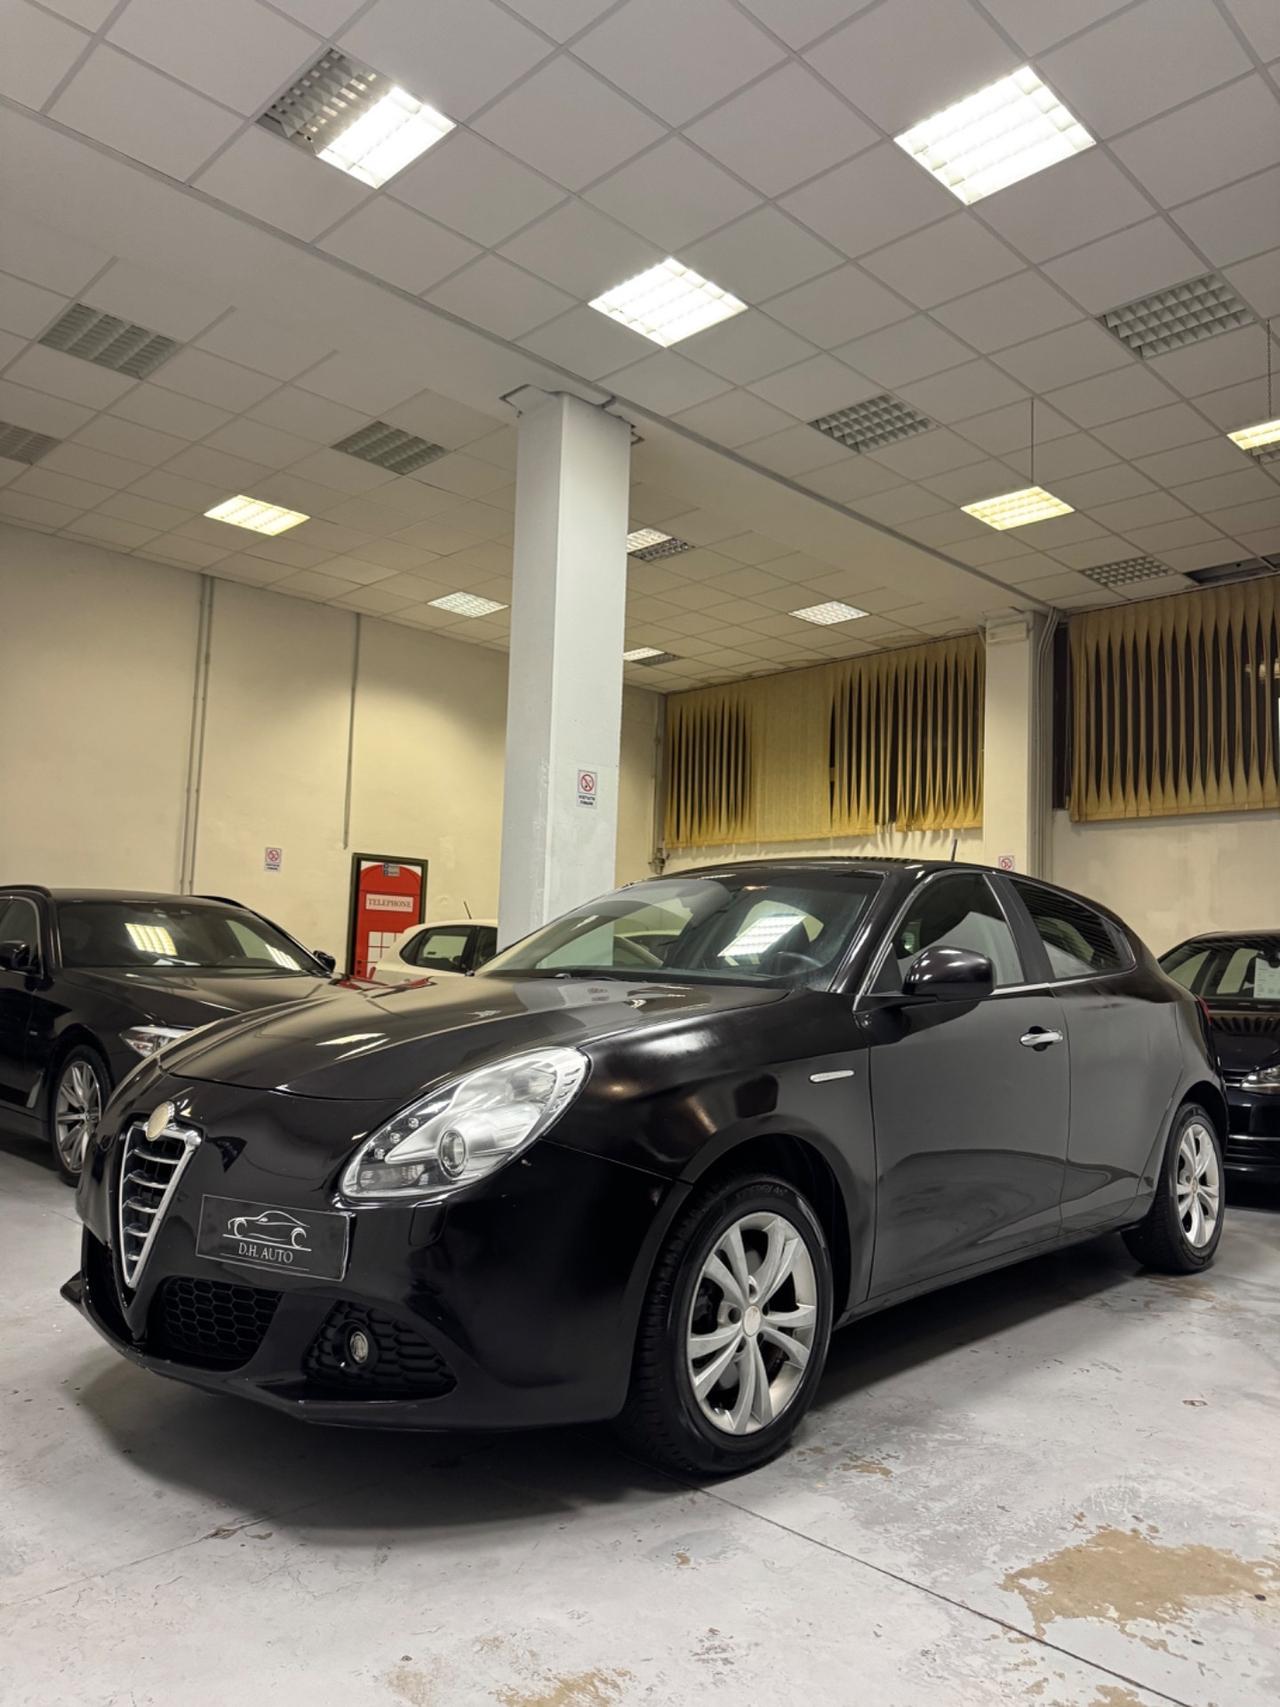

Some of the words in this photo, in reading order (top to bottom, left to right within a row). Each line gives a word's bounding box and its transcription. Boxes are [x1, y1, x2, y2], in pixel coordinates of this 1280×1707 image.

[368, 898, 411, 908] TELEPHONE
[238, 1242, 258, 1257] D.H.
[262, 1248, 293, 1263] AUTO
